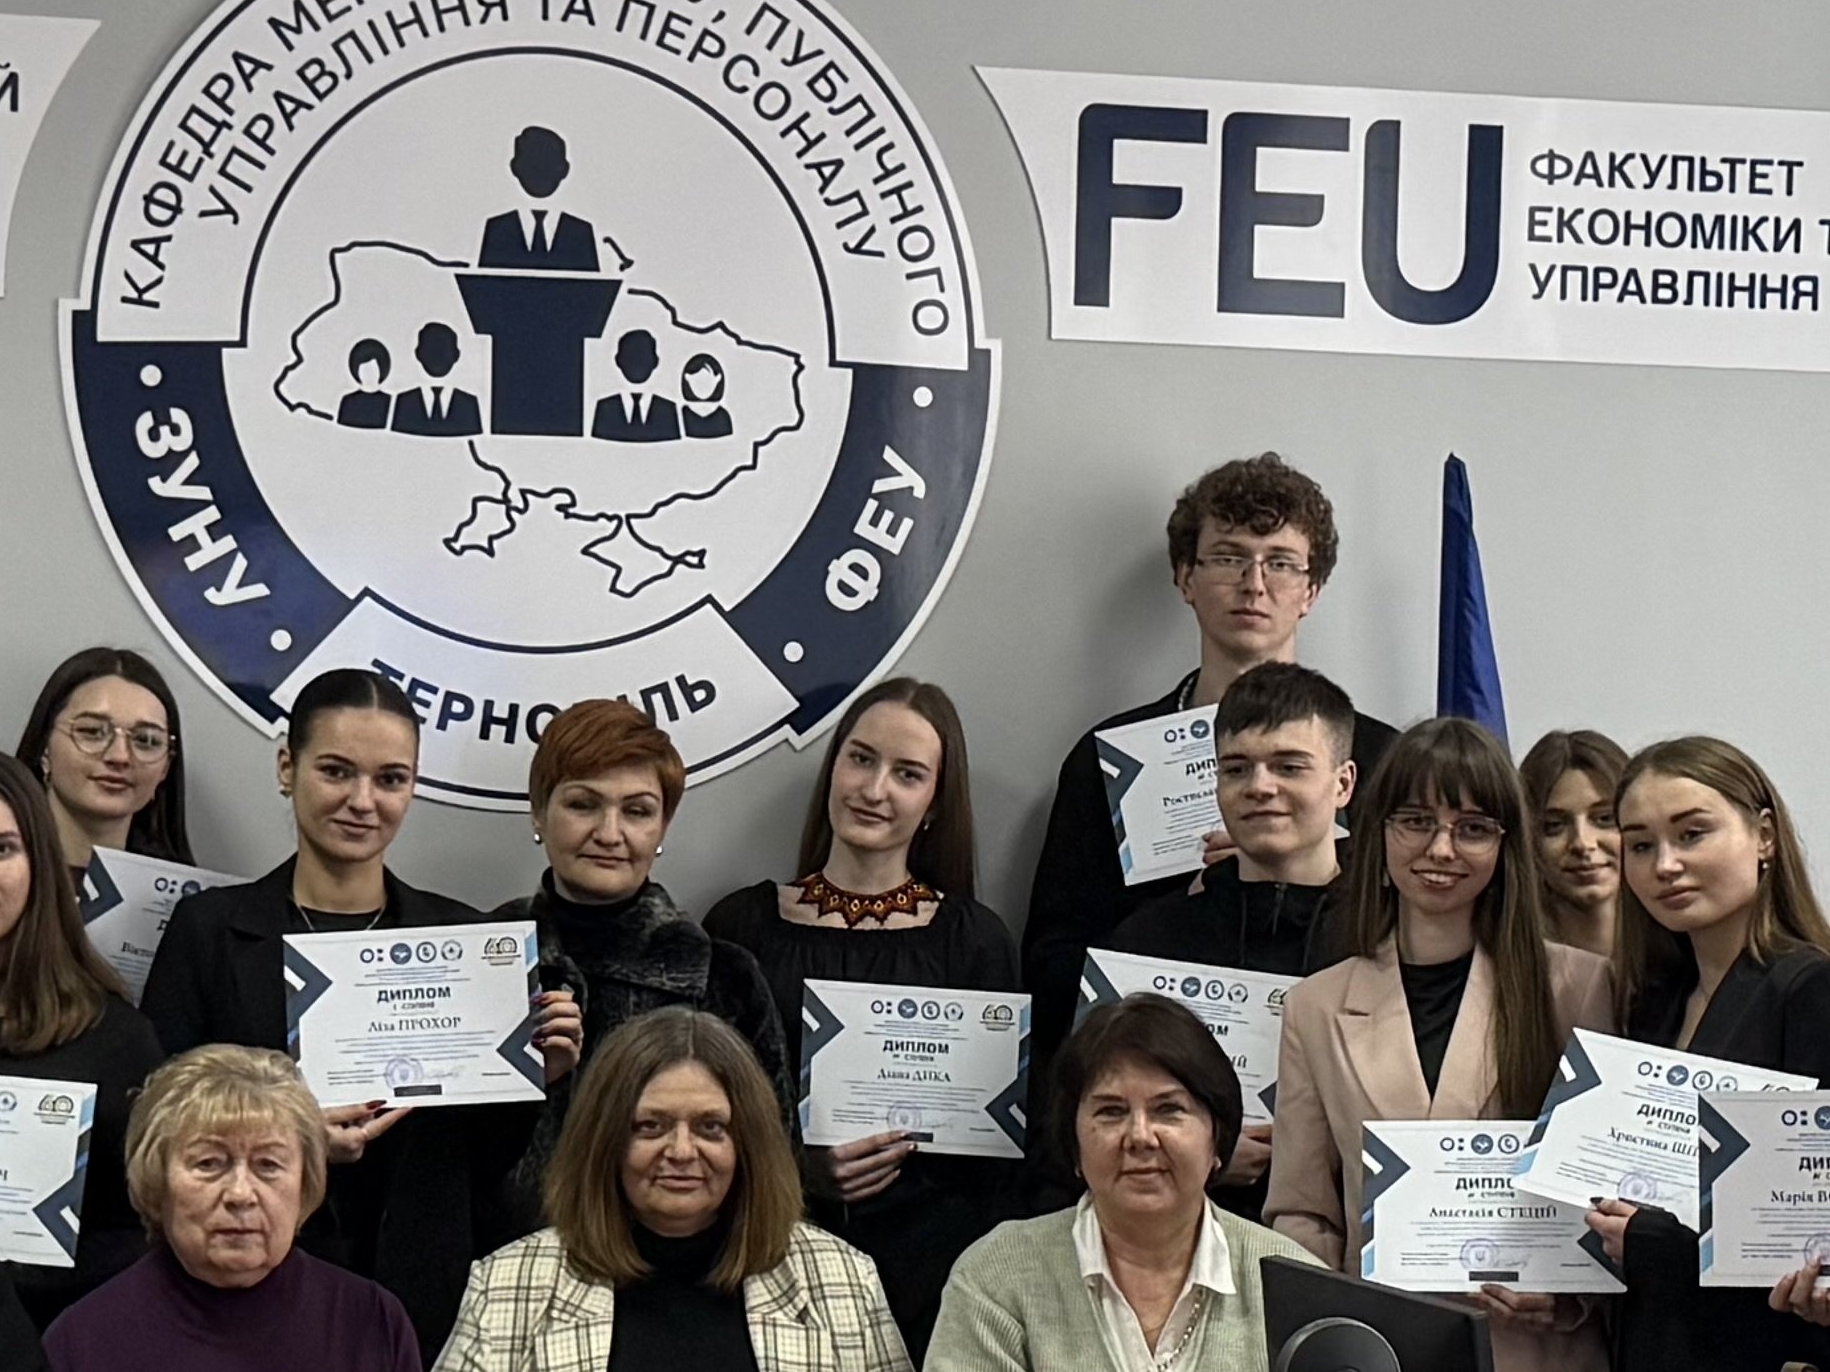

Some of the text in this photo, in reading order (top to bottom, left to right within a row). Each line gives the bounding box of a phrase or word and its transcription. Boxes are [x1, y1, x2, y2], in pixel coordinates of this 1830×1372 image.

[120, 51, 273, 309] КАФЕДРА
[744, 1, 951, 337] ПУБЛІЧНОГО
[1530, 148, 1804, 198] ФАКУЛЬТЕТ
[1074, 103, 1504, 326] FEU
[1527, 205, 1802, 255] ЕКОНОМІКИ
[1529, 262, 1820, 312] УПРАВЛІННЯ
[135, 406, 270, 606] ЗУНУ
[825, 445, 927, 613] ФЕУ
[1185, 758, 1216, 776] ДИП
[377, 986, 451, 1004] ДИПЛОМ
[882, 1039, 950, 1055] ДИПЛОМ
[1636, 1103, 1698, 1126] ДИПЛО
[1455, 1175, 1515, 1191] ДИПЛО
